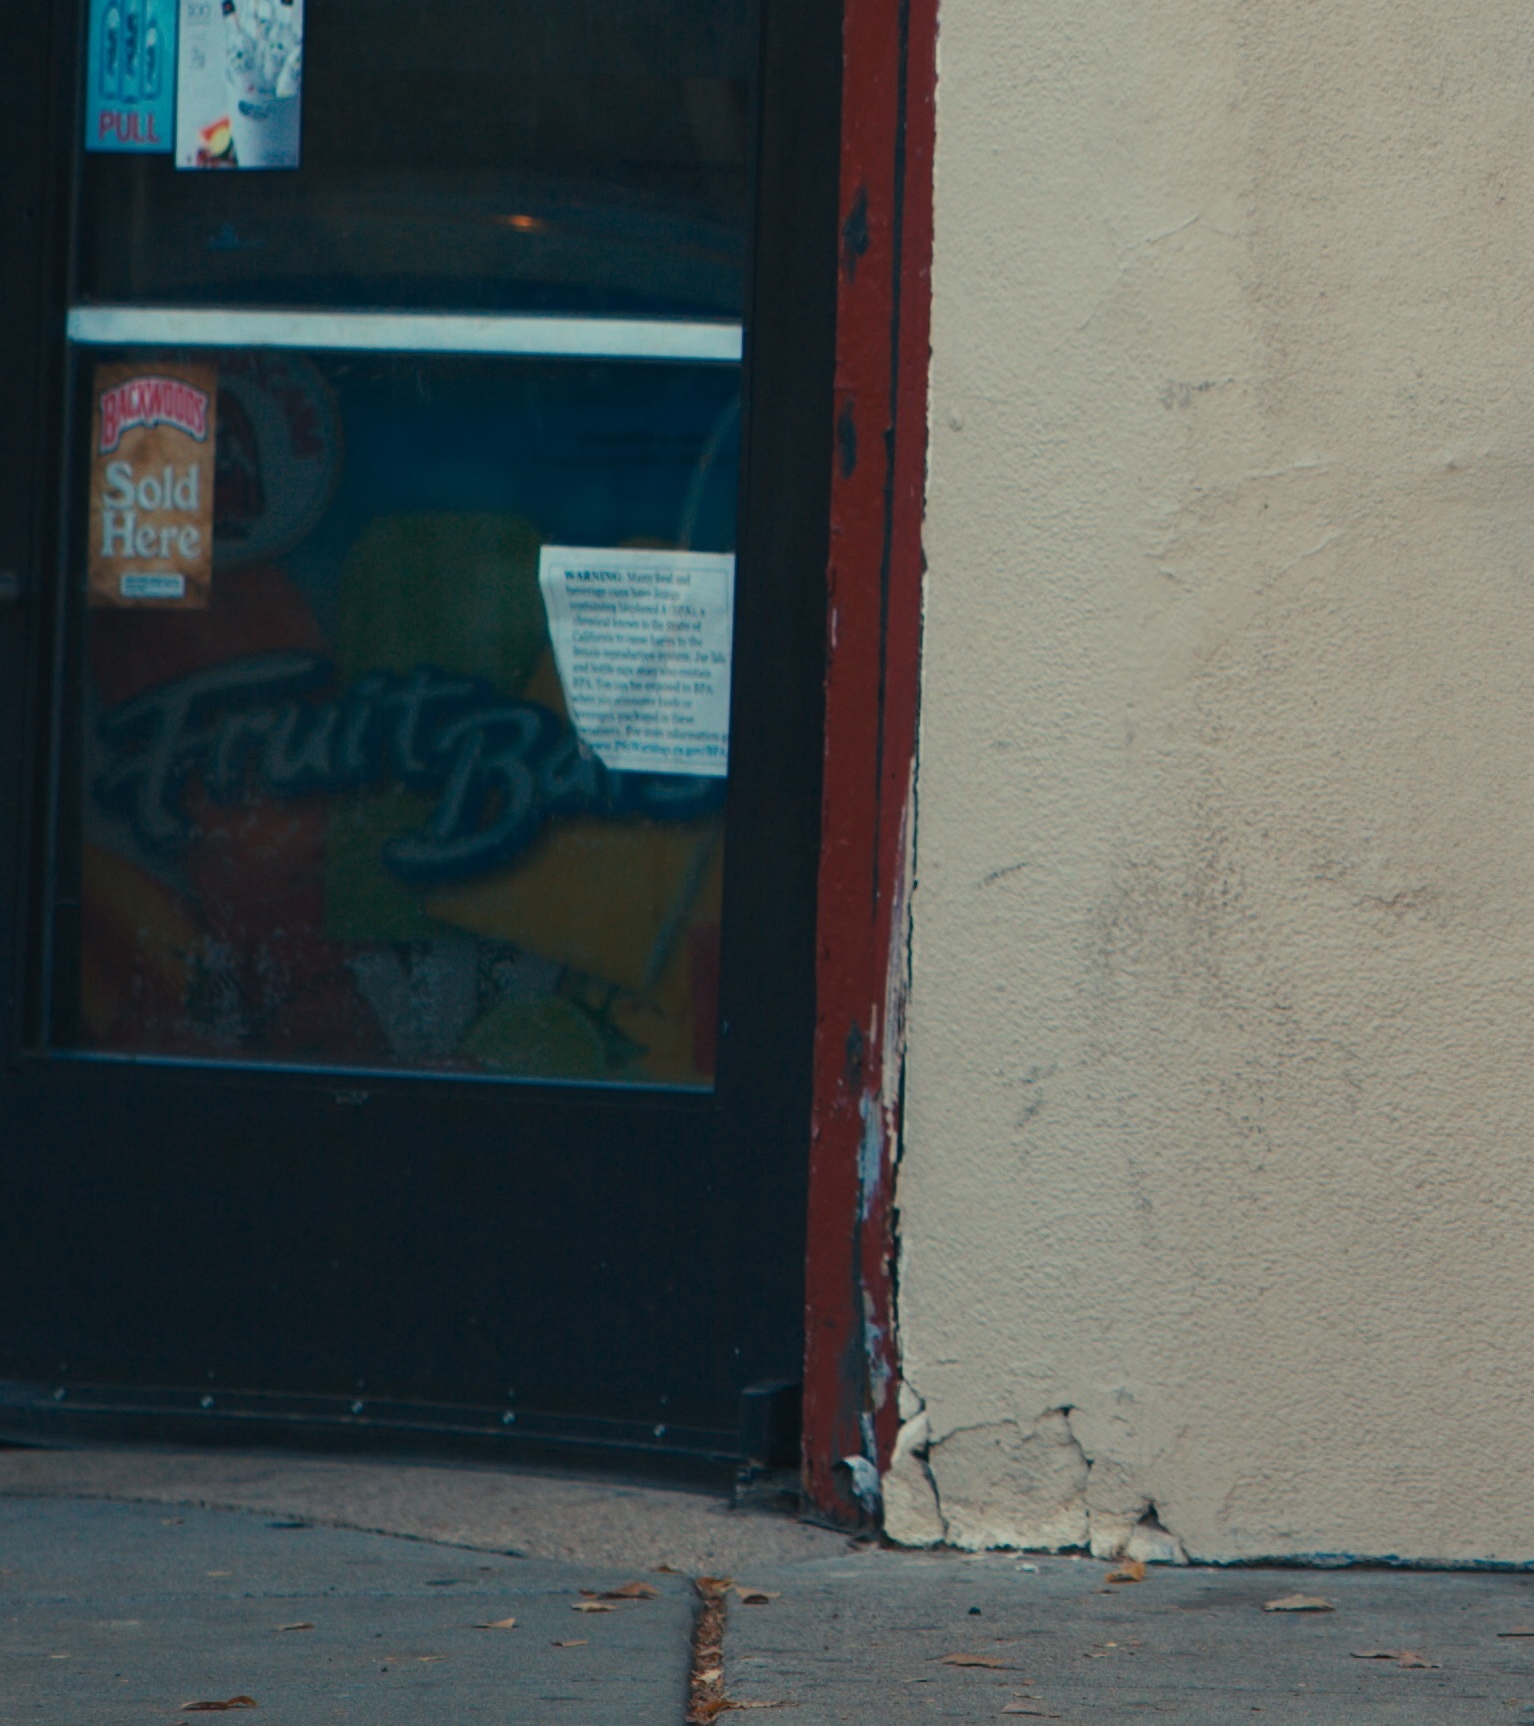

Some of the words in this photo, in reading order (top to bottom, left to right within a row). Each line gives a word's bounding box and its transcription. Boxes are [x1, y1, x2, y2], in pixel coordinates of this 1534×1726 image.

[98, 110, 161, 143] PULL
[101, 378, 209, 449] BACKWOODS
[103, 461, 199, 511] Sold
[101, 510, 200, 559] Here
[98, 646, 480, 842] Fruit
[393, 704, 725, 862] Ba
